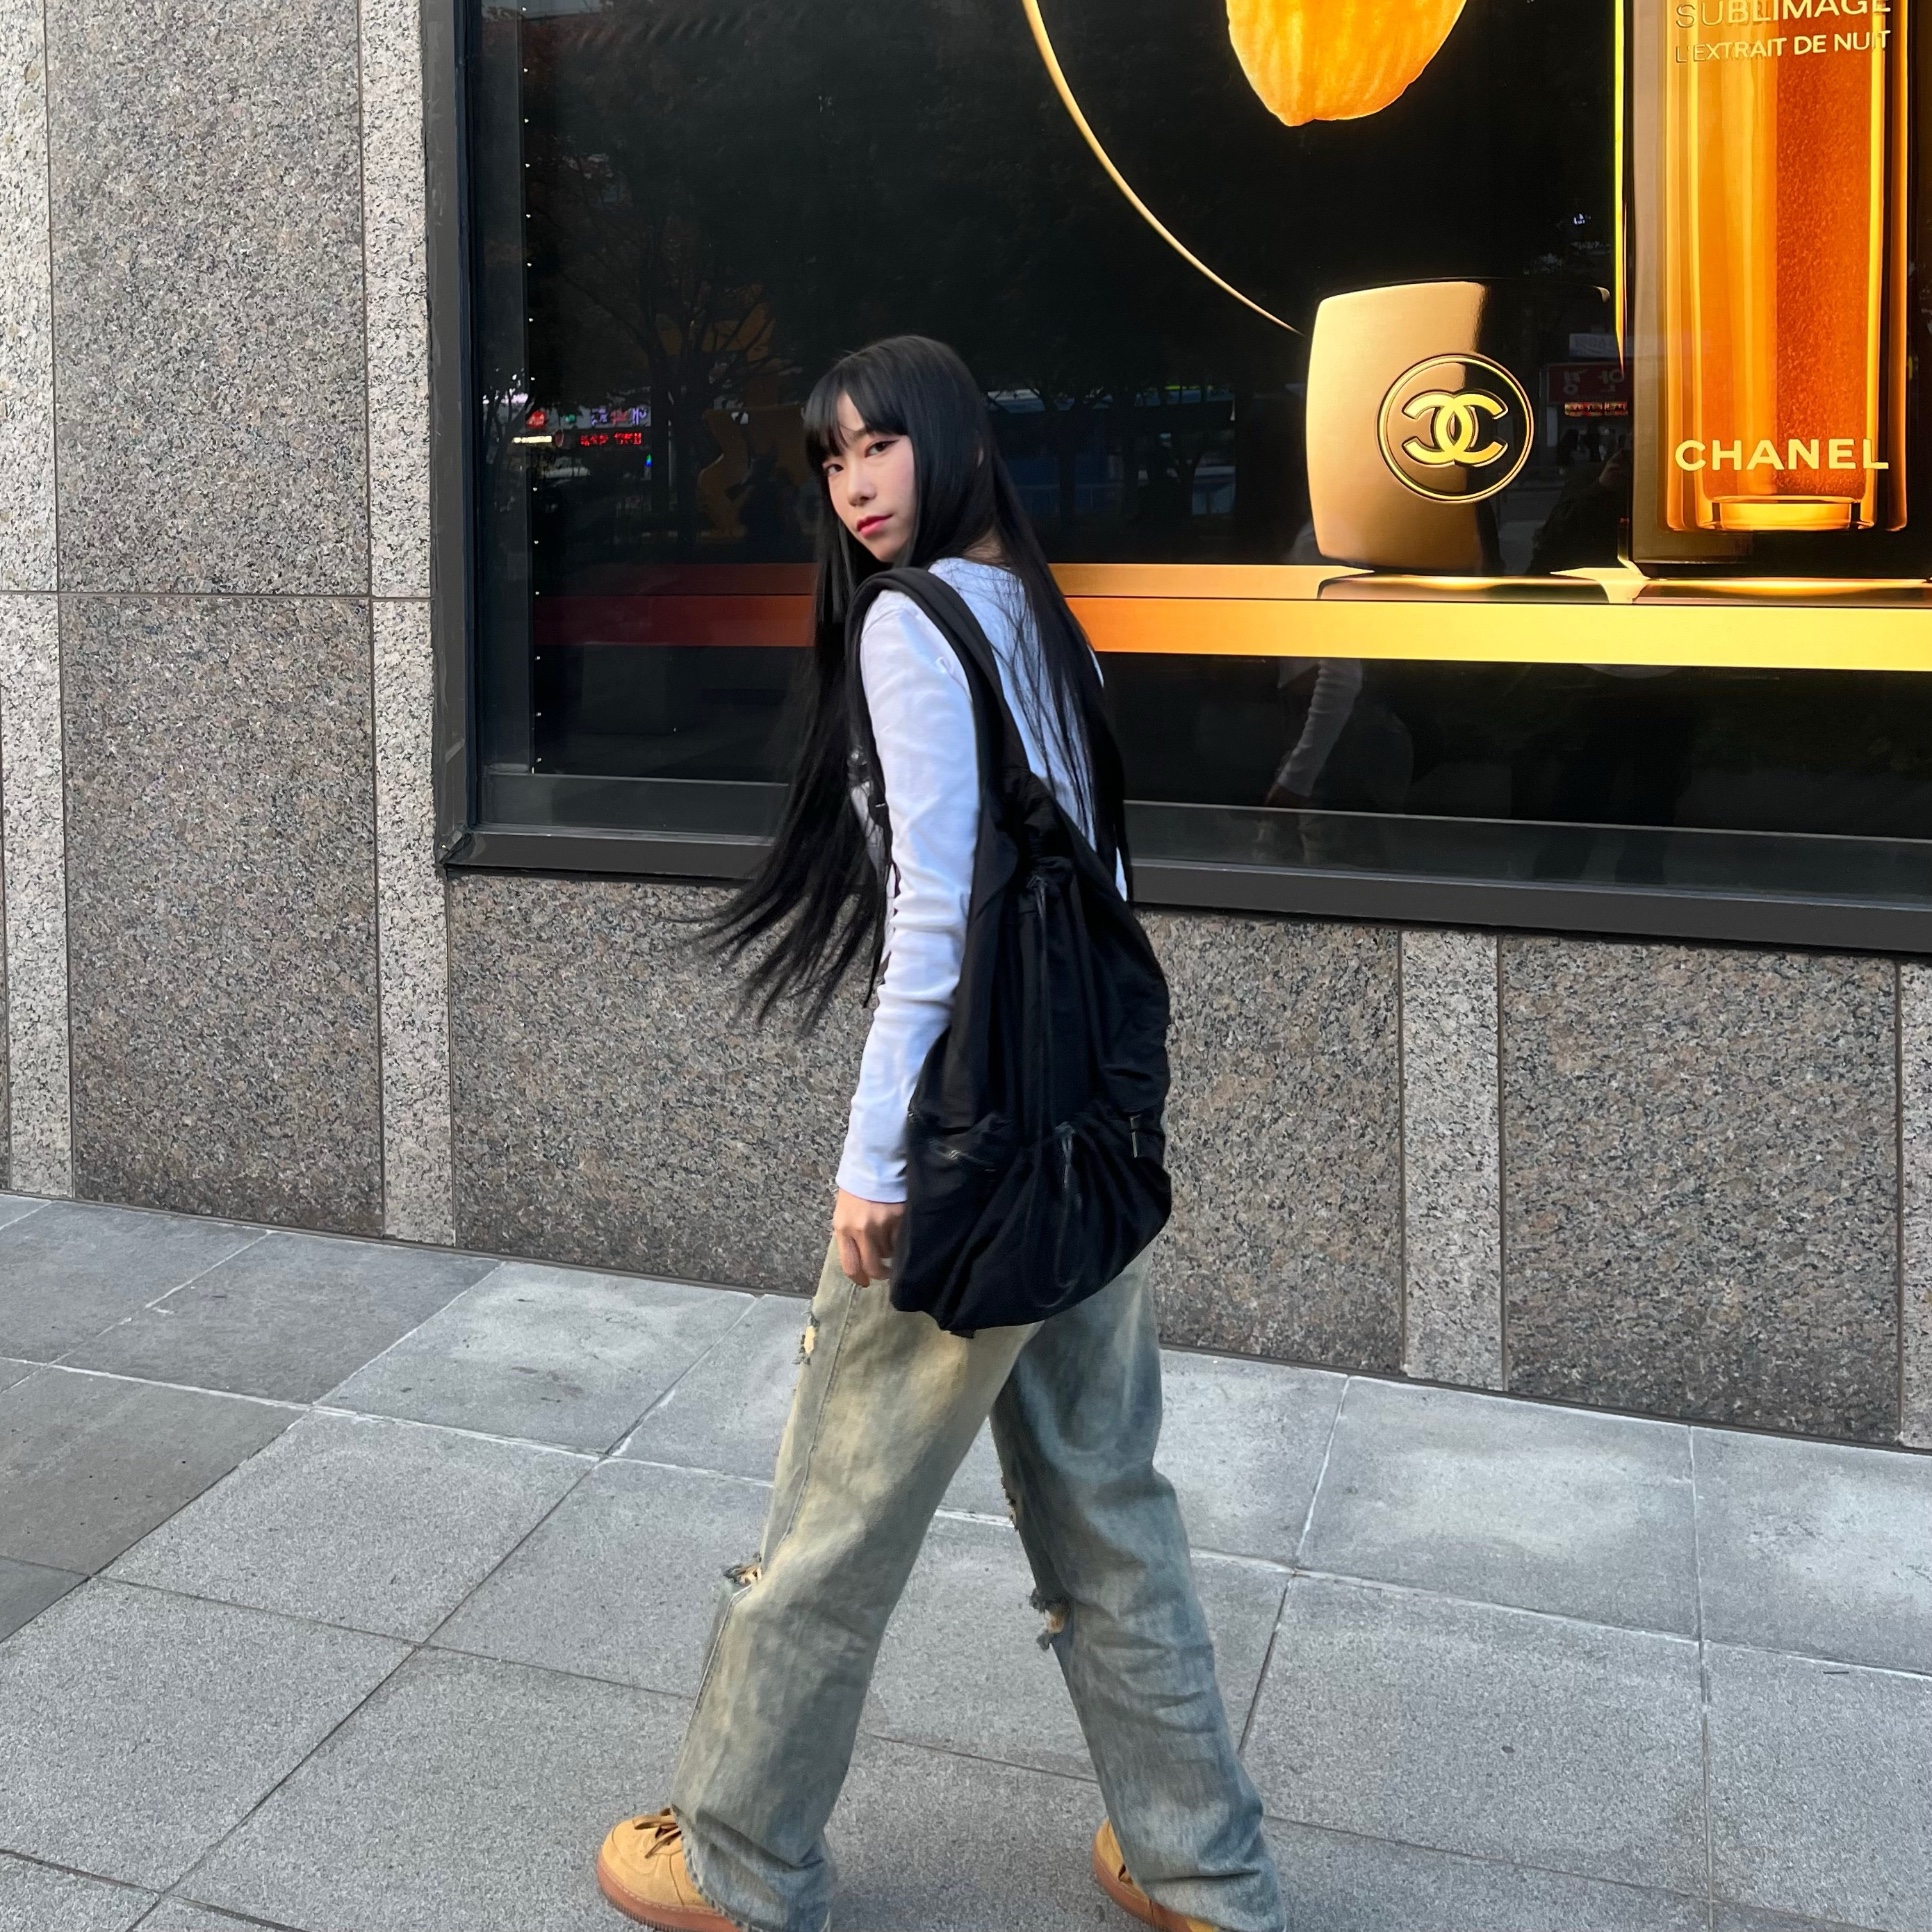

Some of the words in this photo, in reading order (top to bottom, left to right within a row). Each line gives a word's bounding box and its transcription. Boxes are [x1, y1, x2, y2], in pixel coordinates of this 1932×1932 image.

[1676, 0, 1891, 28] SUBLIMAGE
[1676, 37, 1787, 63] L'EXTRAIT
[1793, 34, 1827, 55] DE
[1833, 30, 1891, 52] NUIT
[1674, 437, 1890, 472] CHANEL
